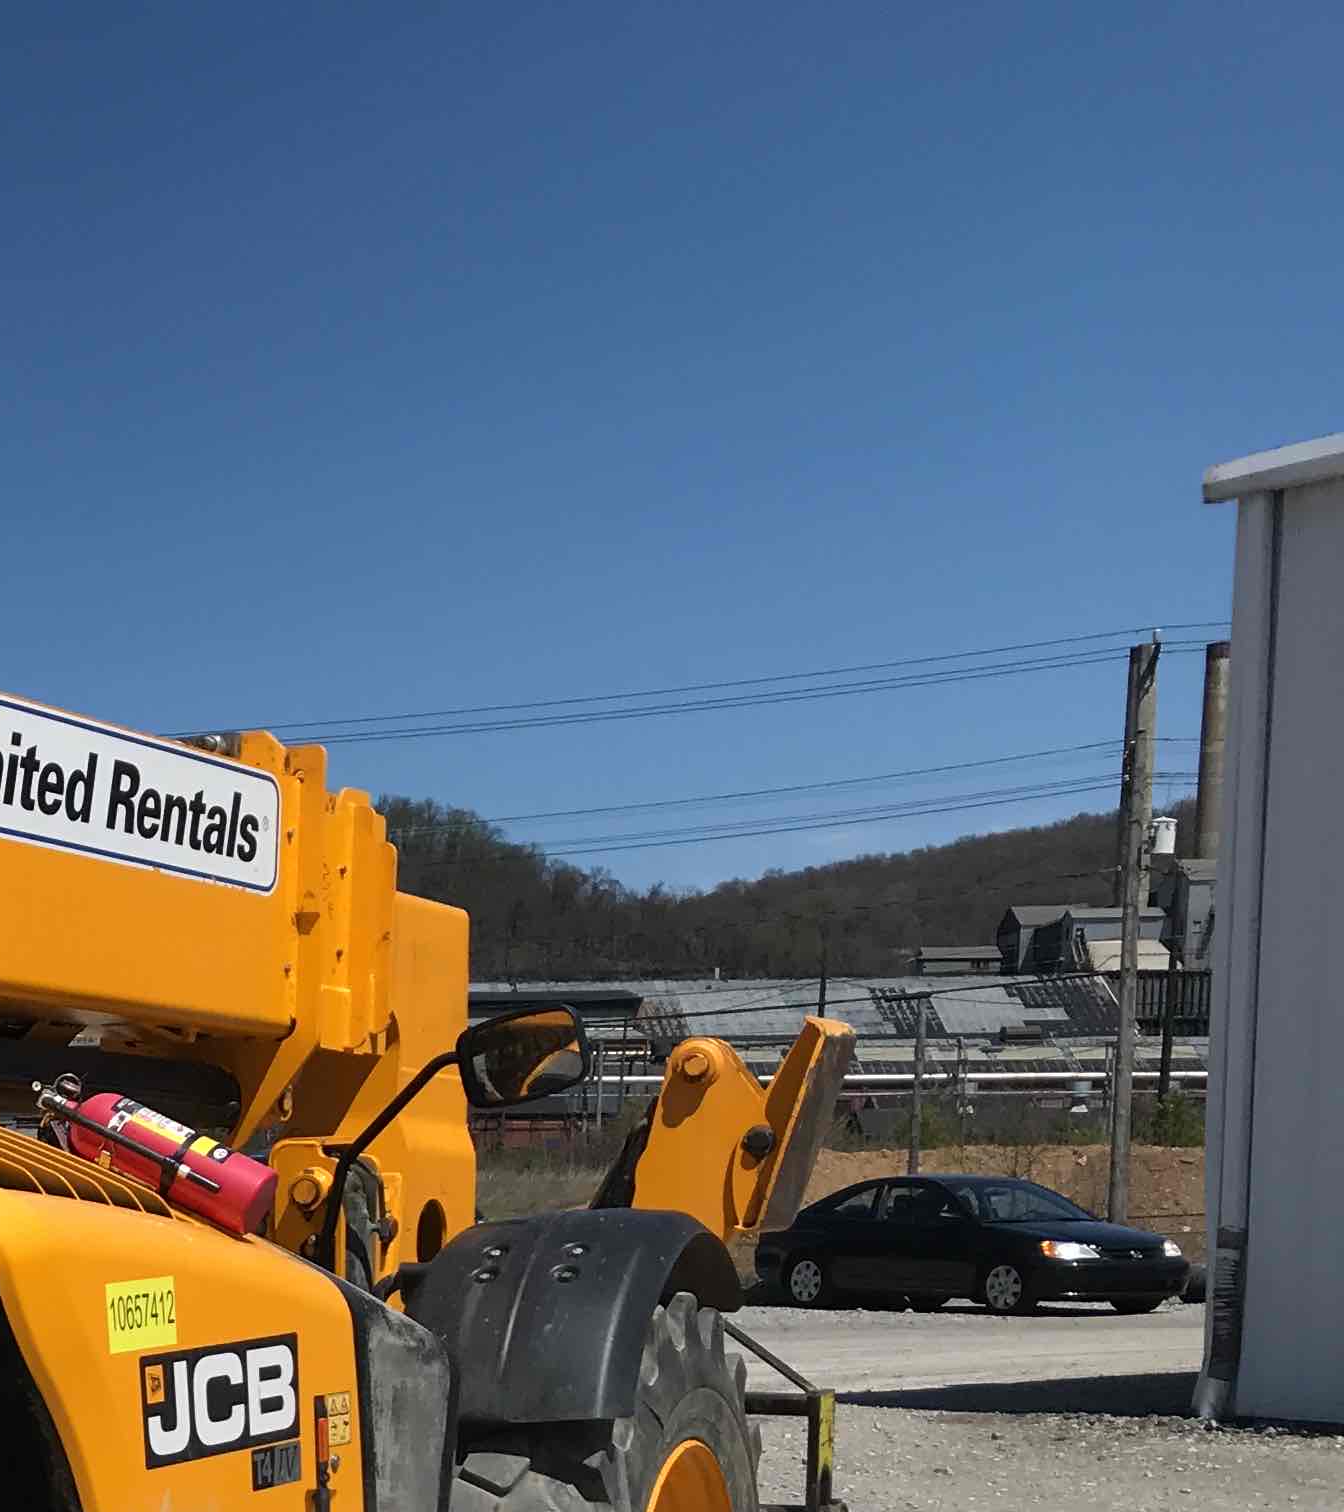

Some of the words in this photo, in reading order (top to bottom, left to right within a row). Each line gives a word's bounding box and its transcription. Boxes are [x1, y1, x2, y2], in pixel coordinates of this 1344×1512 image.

[105, 758, 260, 864] Rentals
[109, 1289, 176, 1332] 10657412
[146, 1343, 296, 1456] JCB
